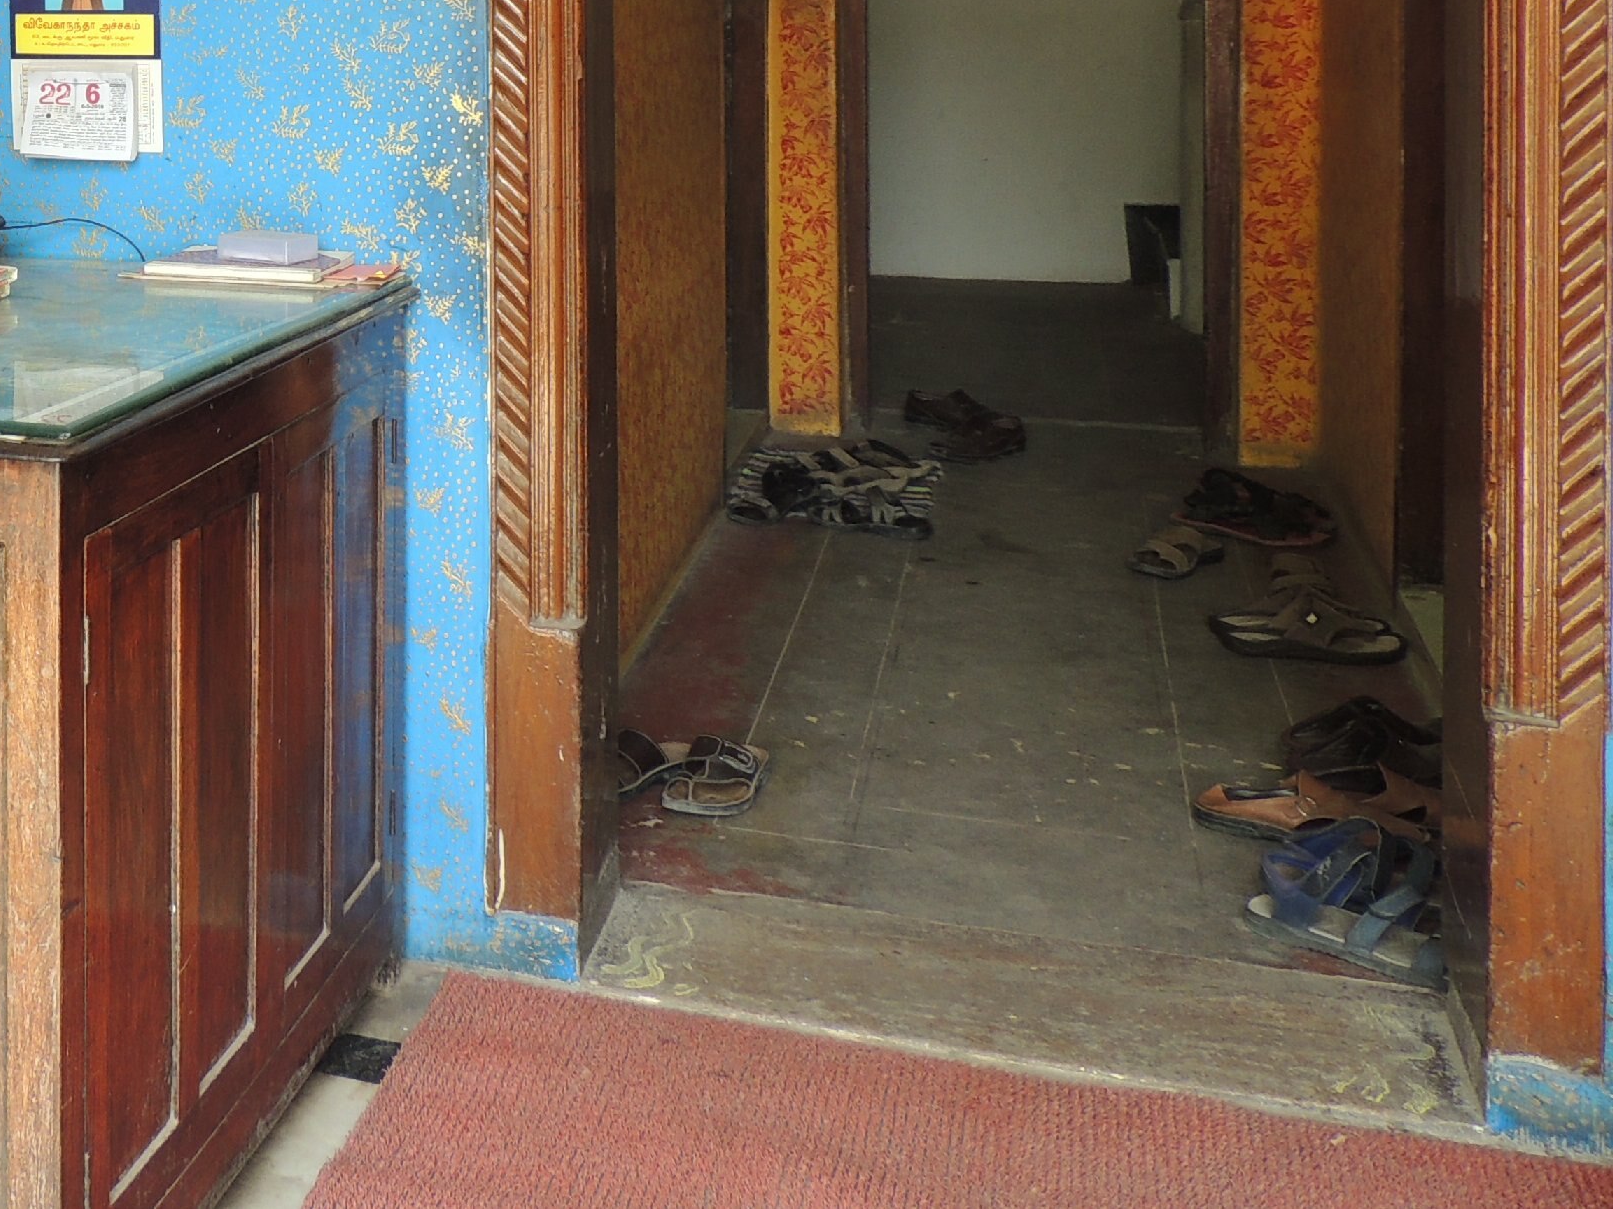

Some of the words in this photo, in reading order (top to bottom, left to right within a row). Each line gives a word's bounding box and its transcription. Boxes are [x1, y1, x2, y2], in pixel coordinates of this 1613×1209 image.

[99, 19, 140, 32] அச்சகம்
[39, 83, 71, 105] 22
[85, 83, 101, 104] 6
